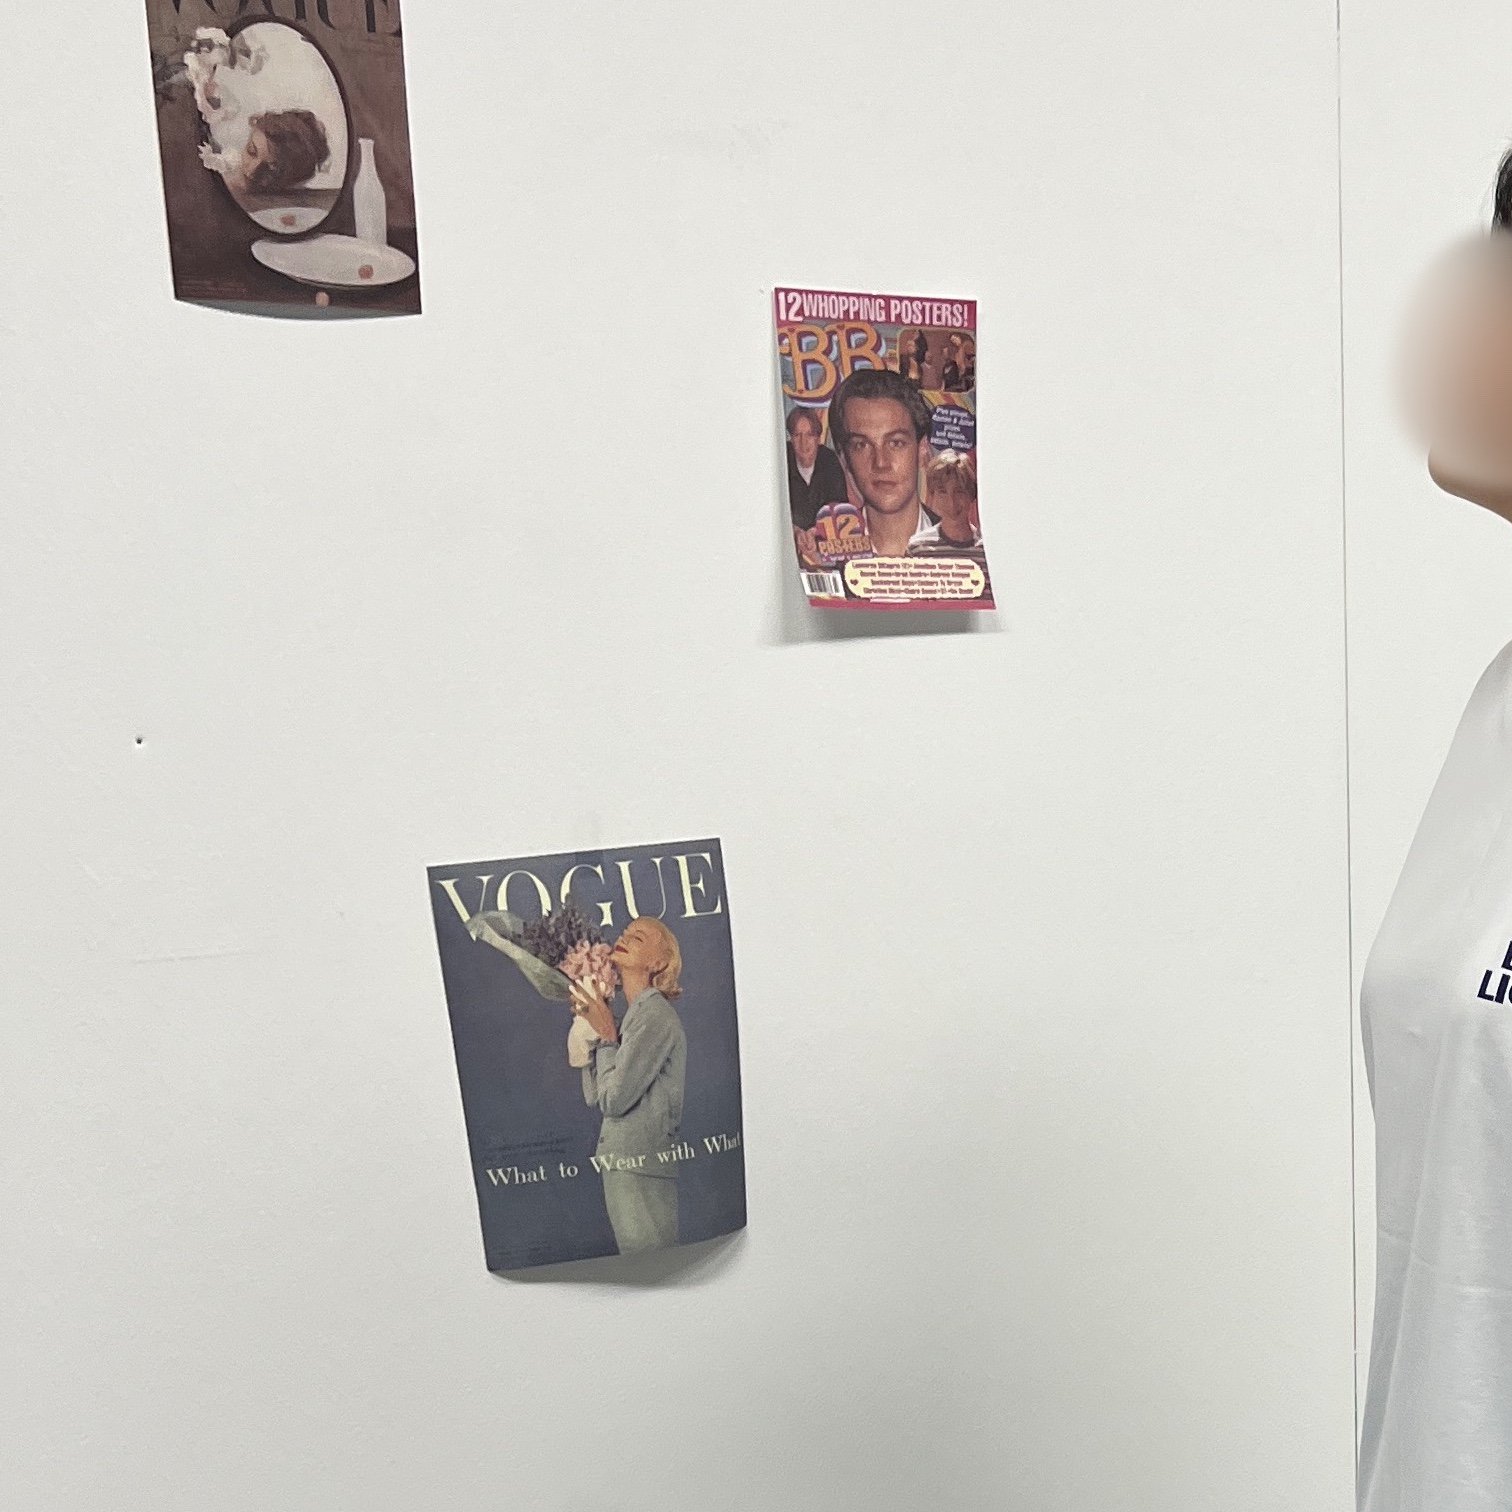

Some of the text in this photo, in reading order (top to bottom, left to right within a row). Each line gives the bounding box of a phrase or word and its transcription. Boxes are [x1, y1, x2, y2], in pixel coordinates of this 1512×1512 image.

[802, 293, 887, 323] WHOPPING
[889, 300, 969, 327] POSTERS!
[816, 514, 864, 541] 12
[434, 852, 723, 942] VOGUE
[486, 1165, 547, 1187] What
[559, 1162, 579, 1178] to
[589, 1153, 647, 1174] Wear
[656, 1141, 695, 1164] with
